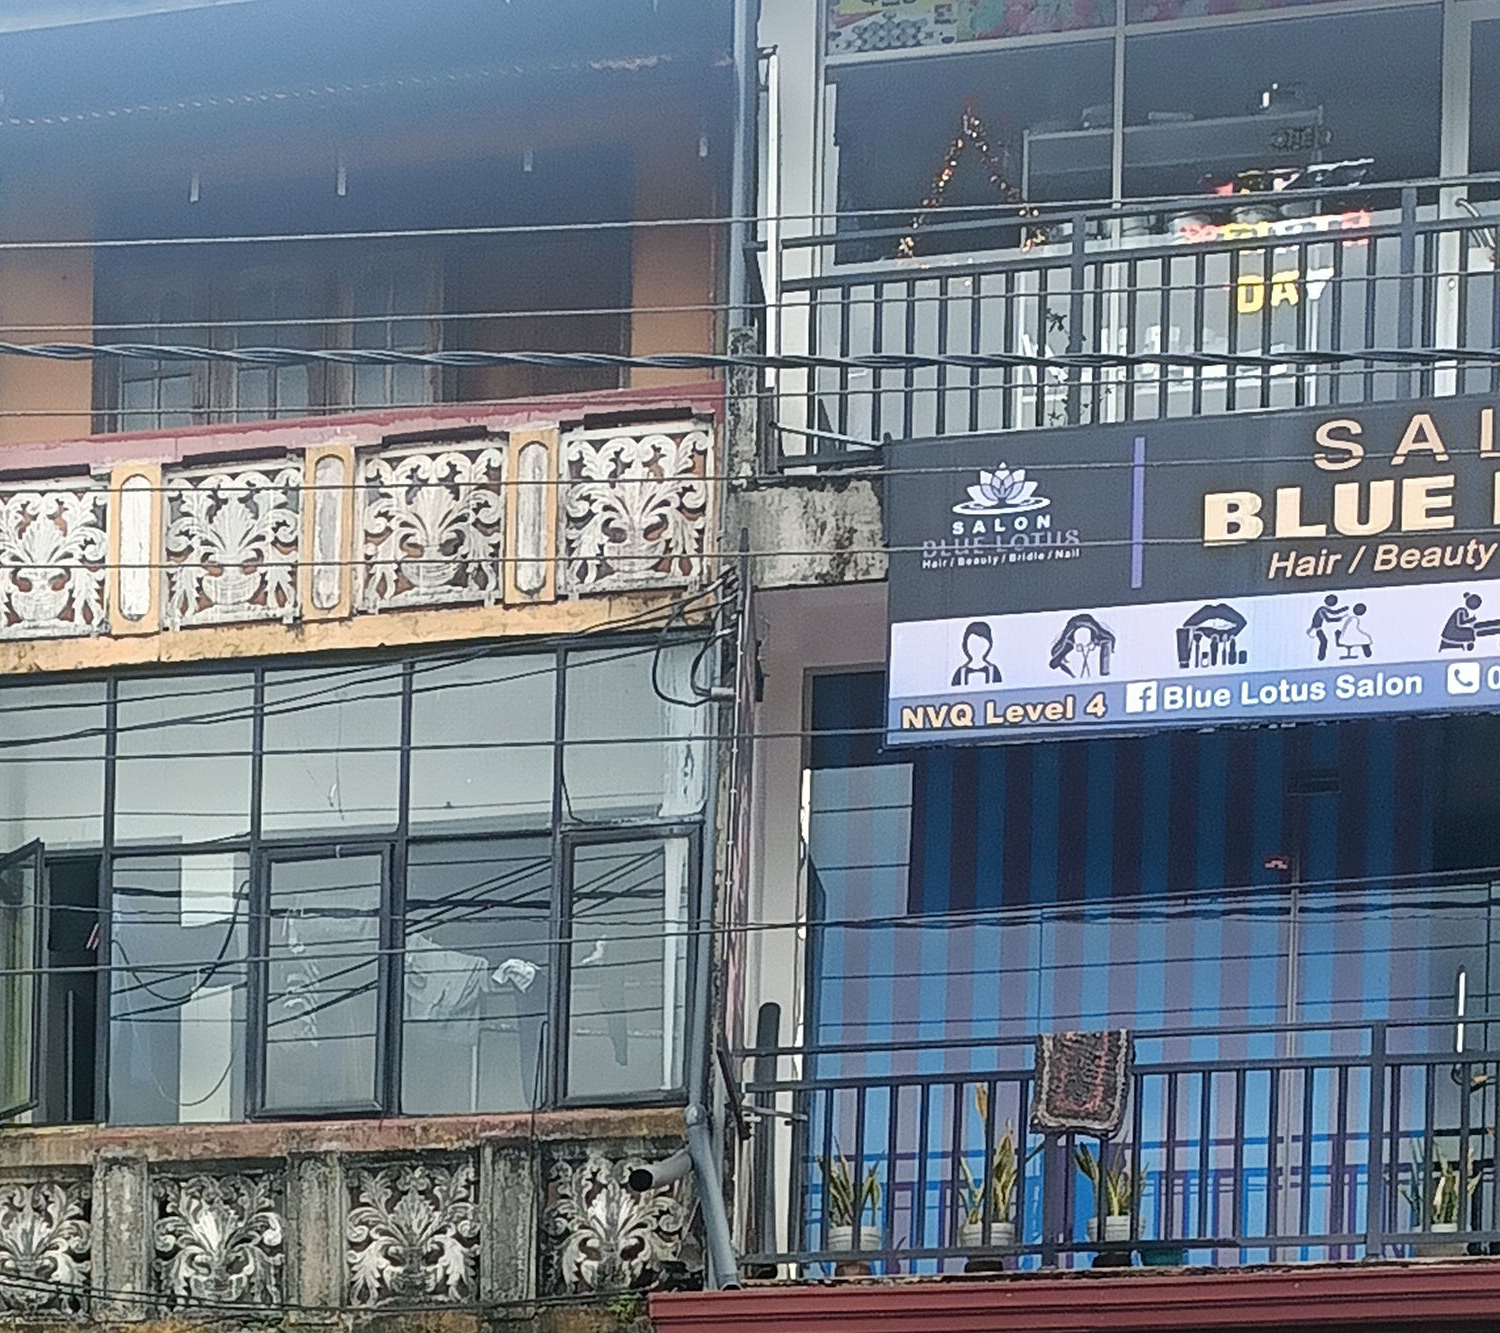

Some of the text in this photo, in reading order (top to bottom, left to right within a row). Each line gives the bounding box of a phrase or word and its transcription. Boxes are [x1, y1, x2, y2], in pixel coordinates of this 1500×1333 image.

[952, 514, 1051, 535] SALON
[1204, 474, 1455, 546] BLUE
[922, 558, 948, 569] Hair
[957, 554, 999, 566] Beauty
[1055, 548, 1080, 559] Nail
[923, 529, 1080, 558] BLUE LOTUS
[1268, 549, 1342, 579] Hair
[1373, 538, 1498, 571] Beauty
[1163, 672, 1422, 711] Blue Lotus Salon
[901, 693, 1107, 730] NVQ Level 4
